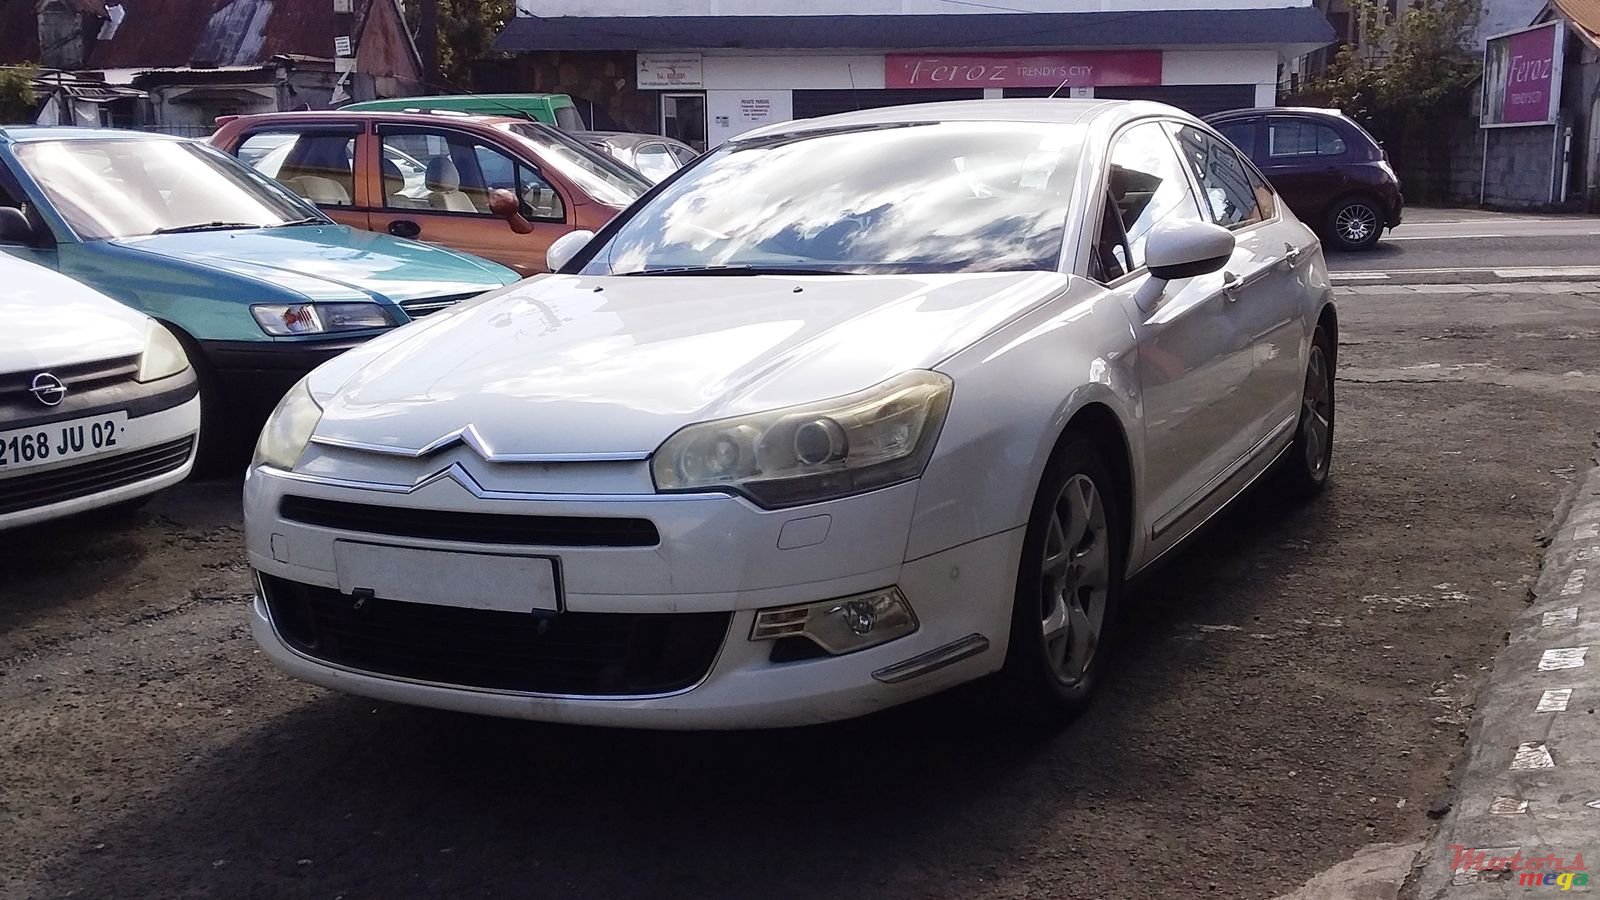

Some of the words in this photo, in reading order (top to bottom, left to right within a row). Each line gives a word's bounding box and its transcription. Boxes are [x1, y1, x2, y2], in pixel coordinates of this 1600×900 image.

[904, 59, 1007, 85] Feroz
[1016, 65, 1067, 77] TRENDY'S
[1069, 65, 1093, 77] CITY
[1508, 55, 1552, 87] Feroz
[56, 425, 85, 456] JU
[91, 420, 117, 449] 02
